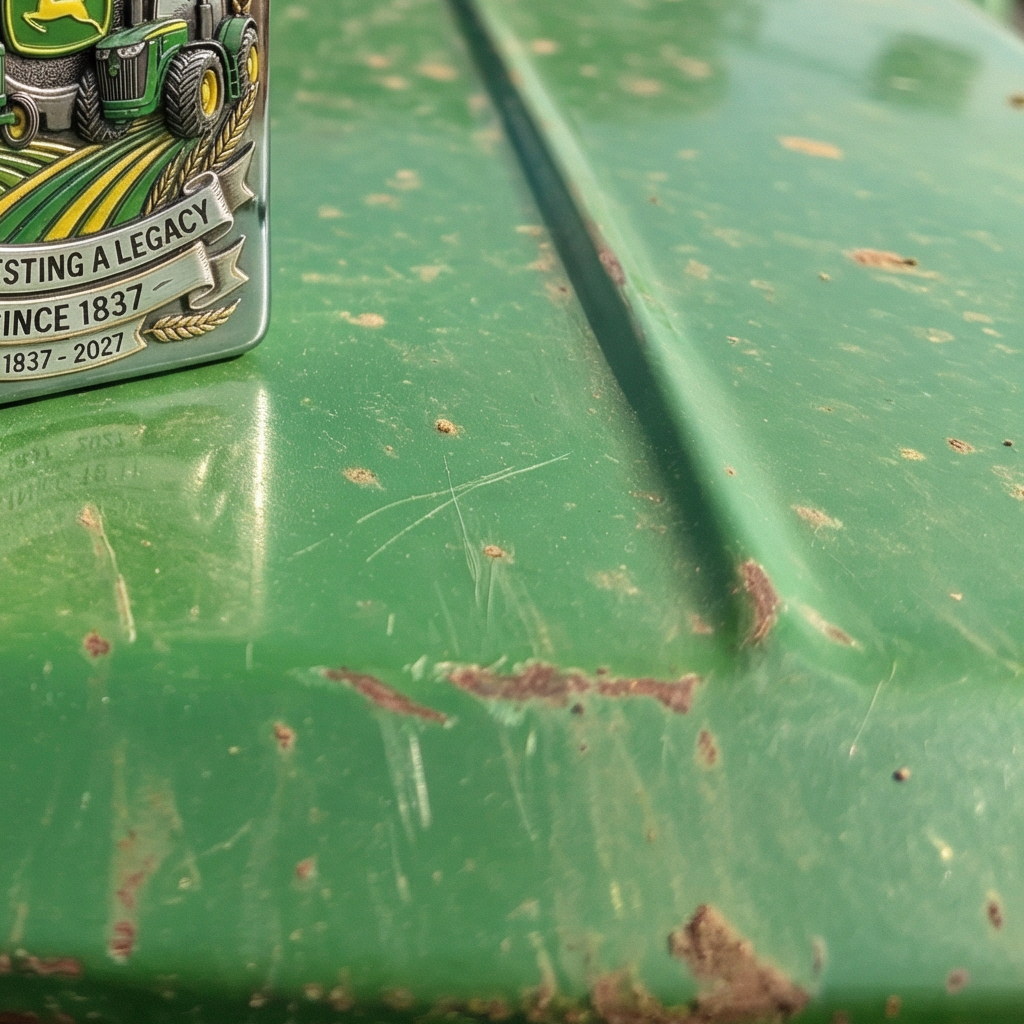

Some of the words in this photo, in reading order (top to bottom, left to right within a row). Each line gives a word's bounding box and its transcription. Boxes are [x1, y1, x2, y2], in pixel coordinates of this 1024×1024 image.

[92, 244, 111, 274] A
[115, 198, 212, 266] LEGACY
[77, 282, 144, 326] 1837
[3, 348, 53, 374] 1837
[72, 331, 125, 365] 2027
